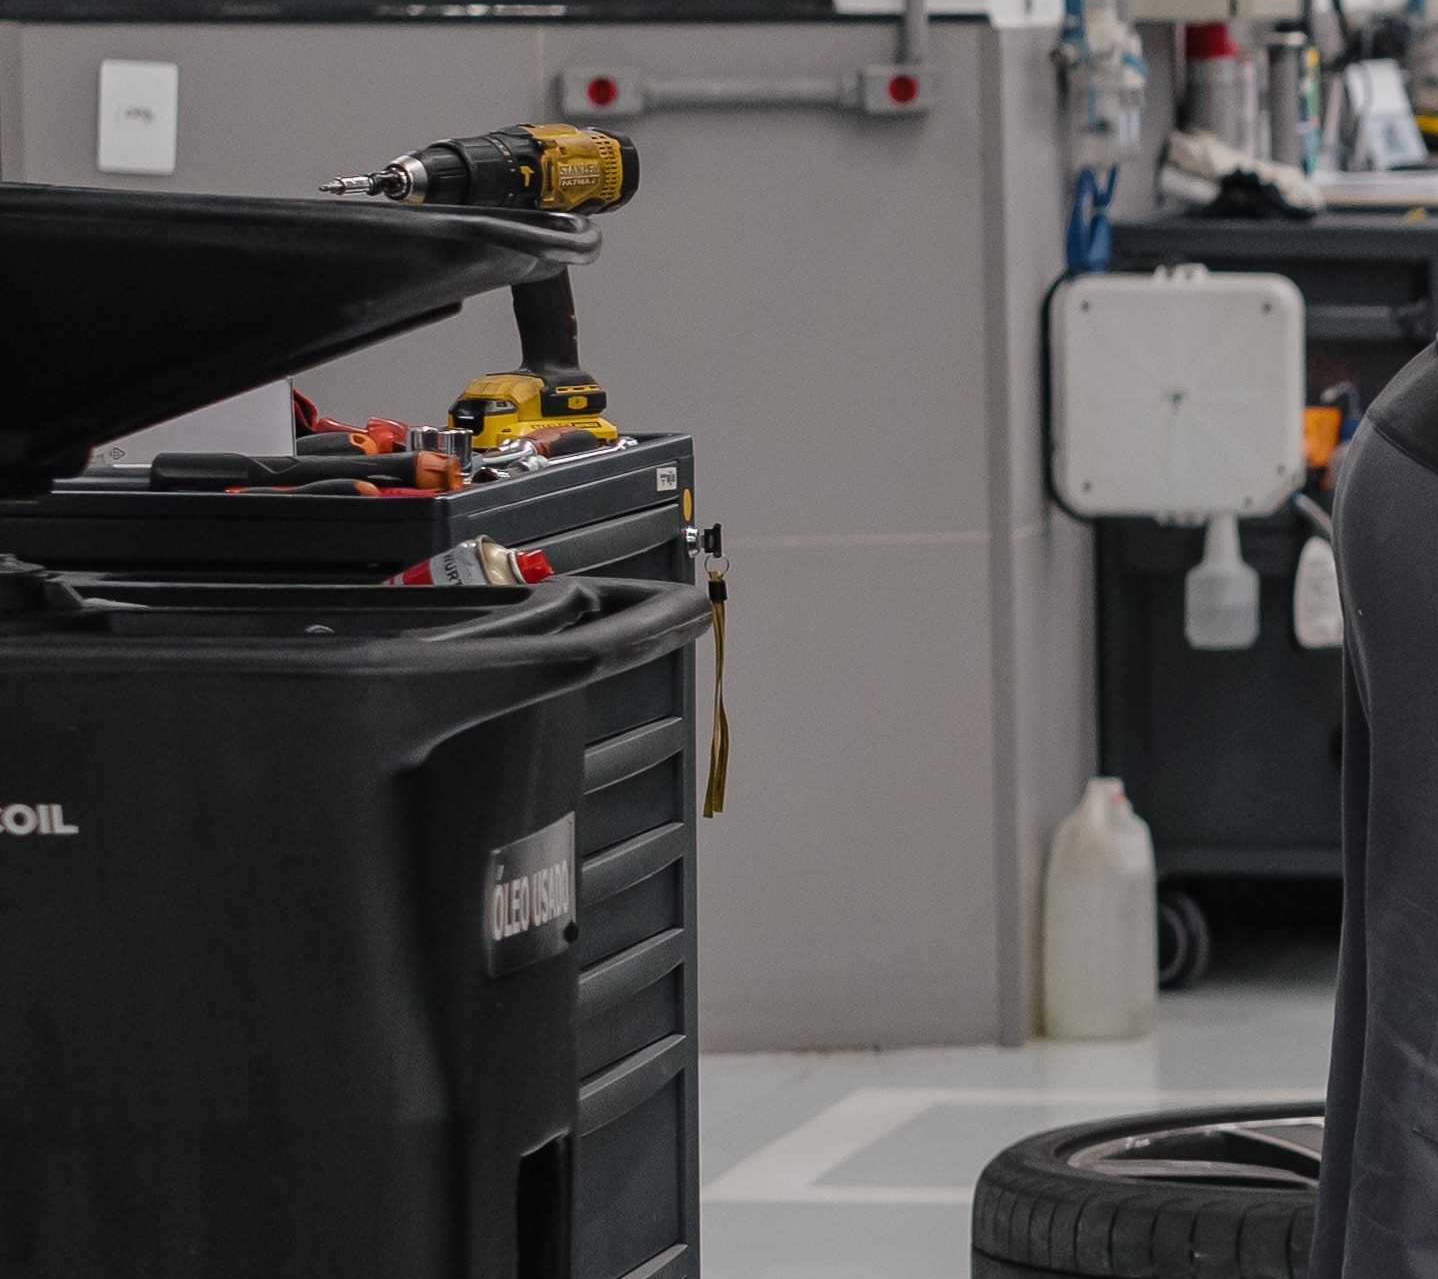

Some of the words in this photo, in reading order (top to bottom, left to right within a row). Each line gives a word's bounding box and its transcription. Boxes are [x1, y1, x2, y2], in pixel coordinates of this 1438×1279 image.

[0, 803, 80, 835] OIL
[494, 864, 530, 941] ÓLEO
[532, 859, 570, 927] USADO
